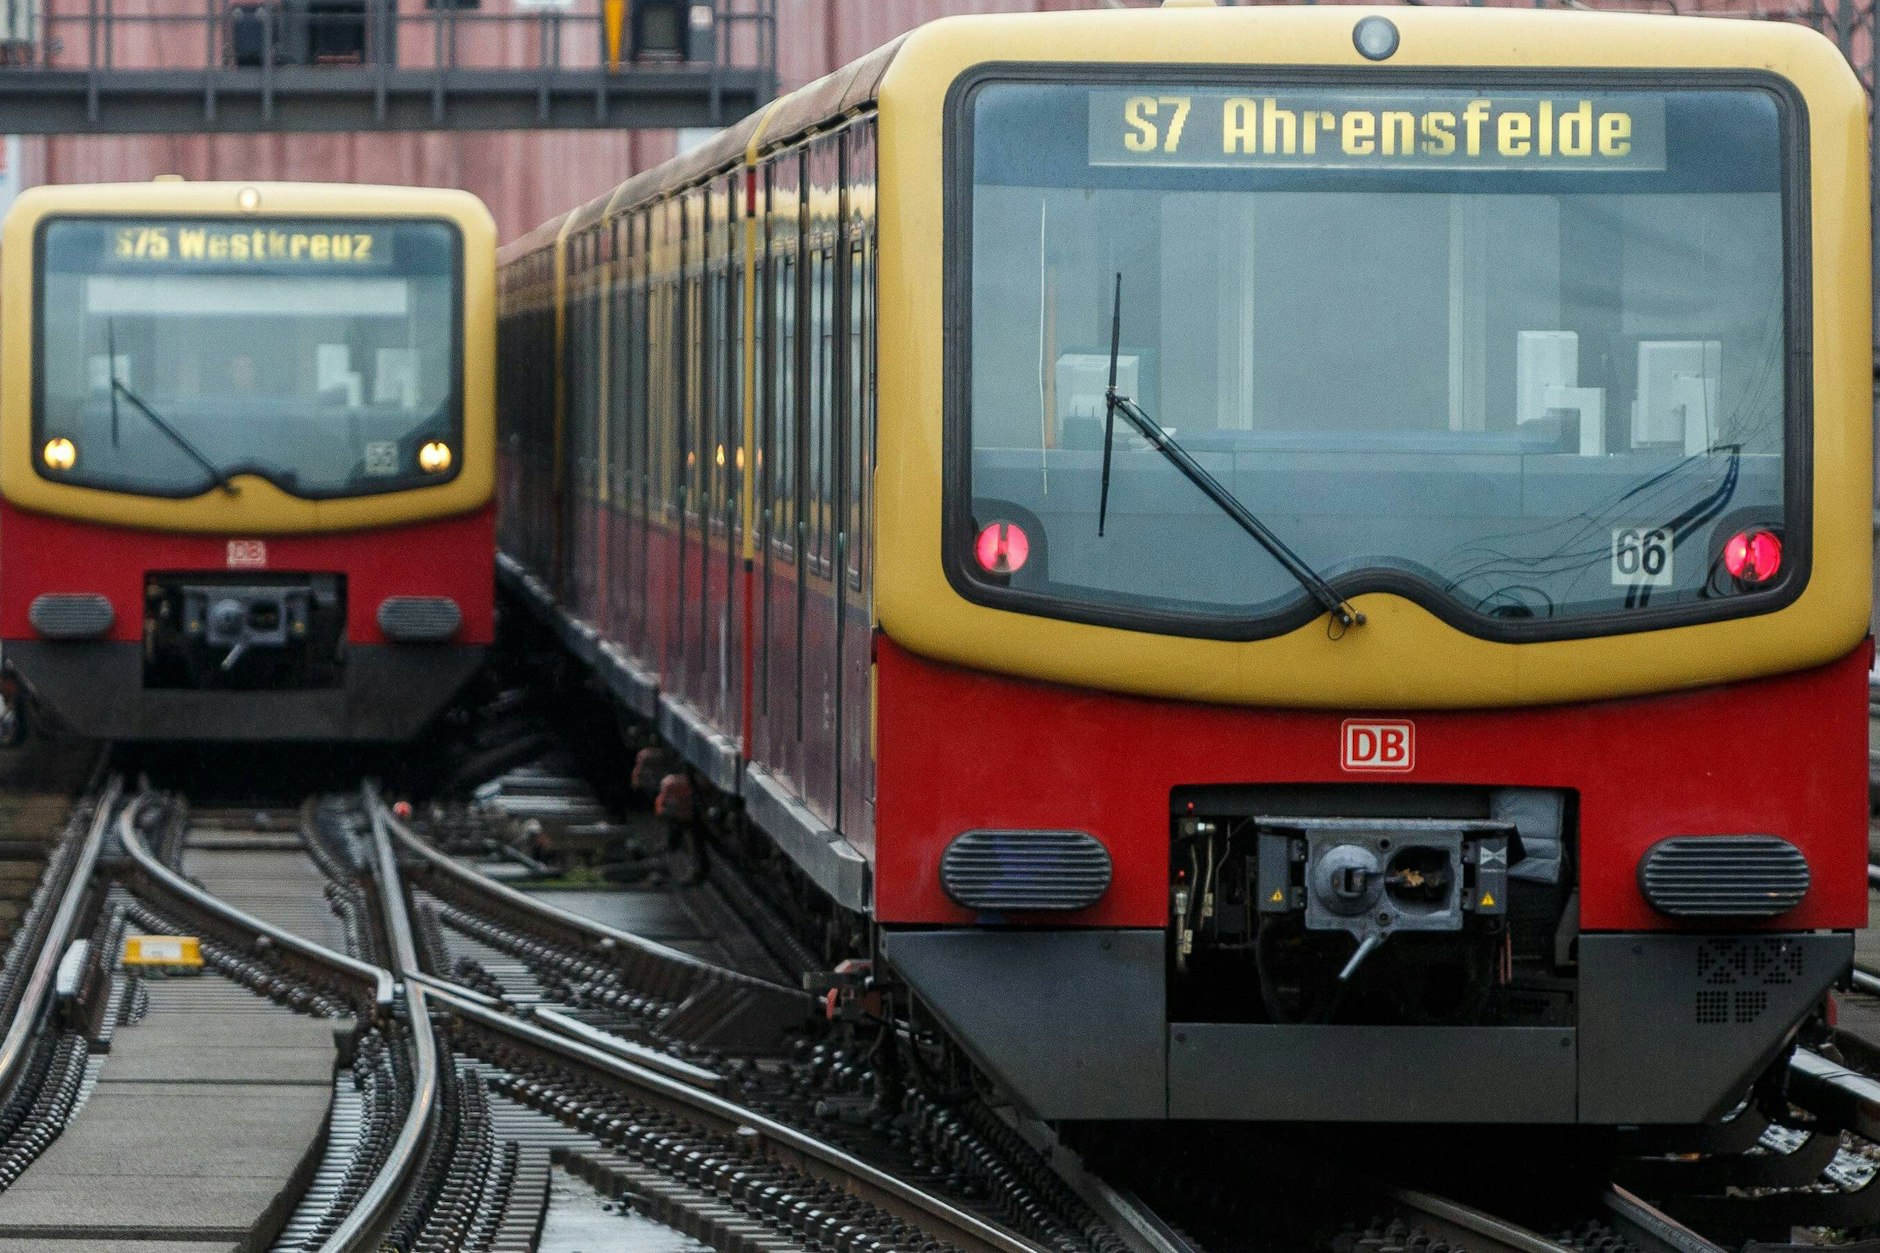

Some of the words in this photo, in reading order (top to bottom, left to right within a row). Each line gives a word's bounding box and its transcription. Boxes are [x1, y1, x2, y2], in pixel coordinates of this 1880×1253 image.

[1124, 96, 1191, 154] S7
[1223, 97, 1632, 157] Ahrensfelde
[115, 227, 170, 261] S75
[178, 227, 373, 262] Westkreuz
[1617, 529, 1666, 575] 66
[1352, 728, 1405, 762] DB
